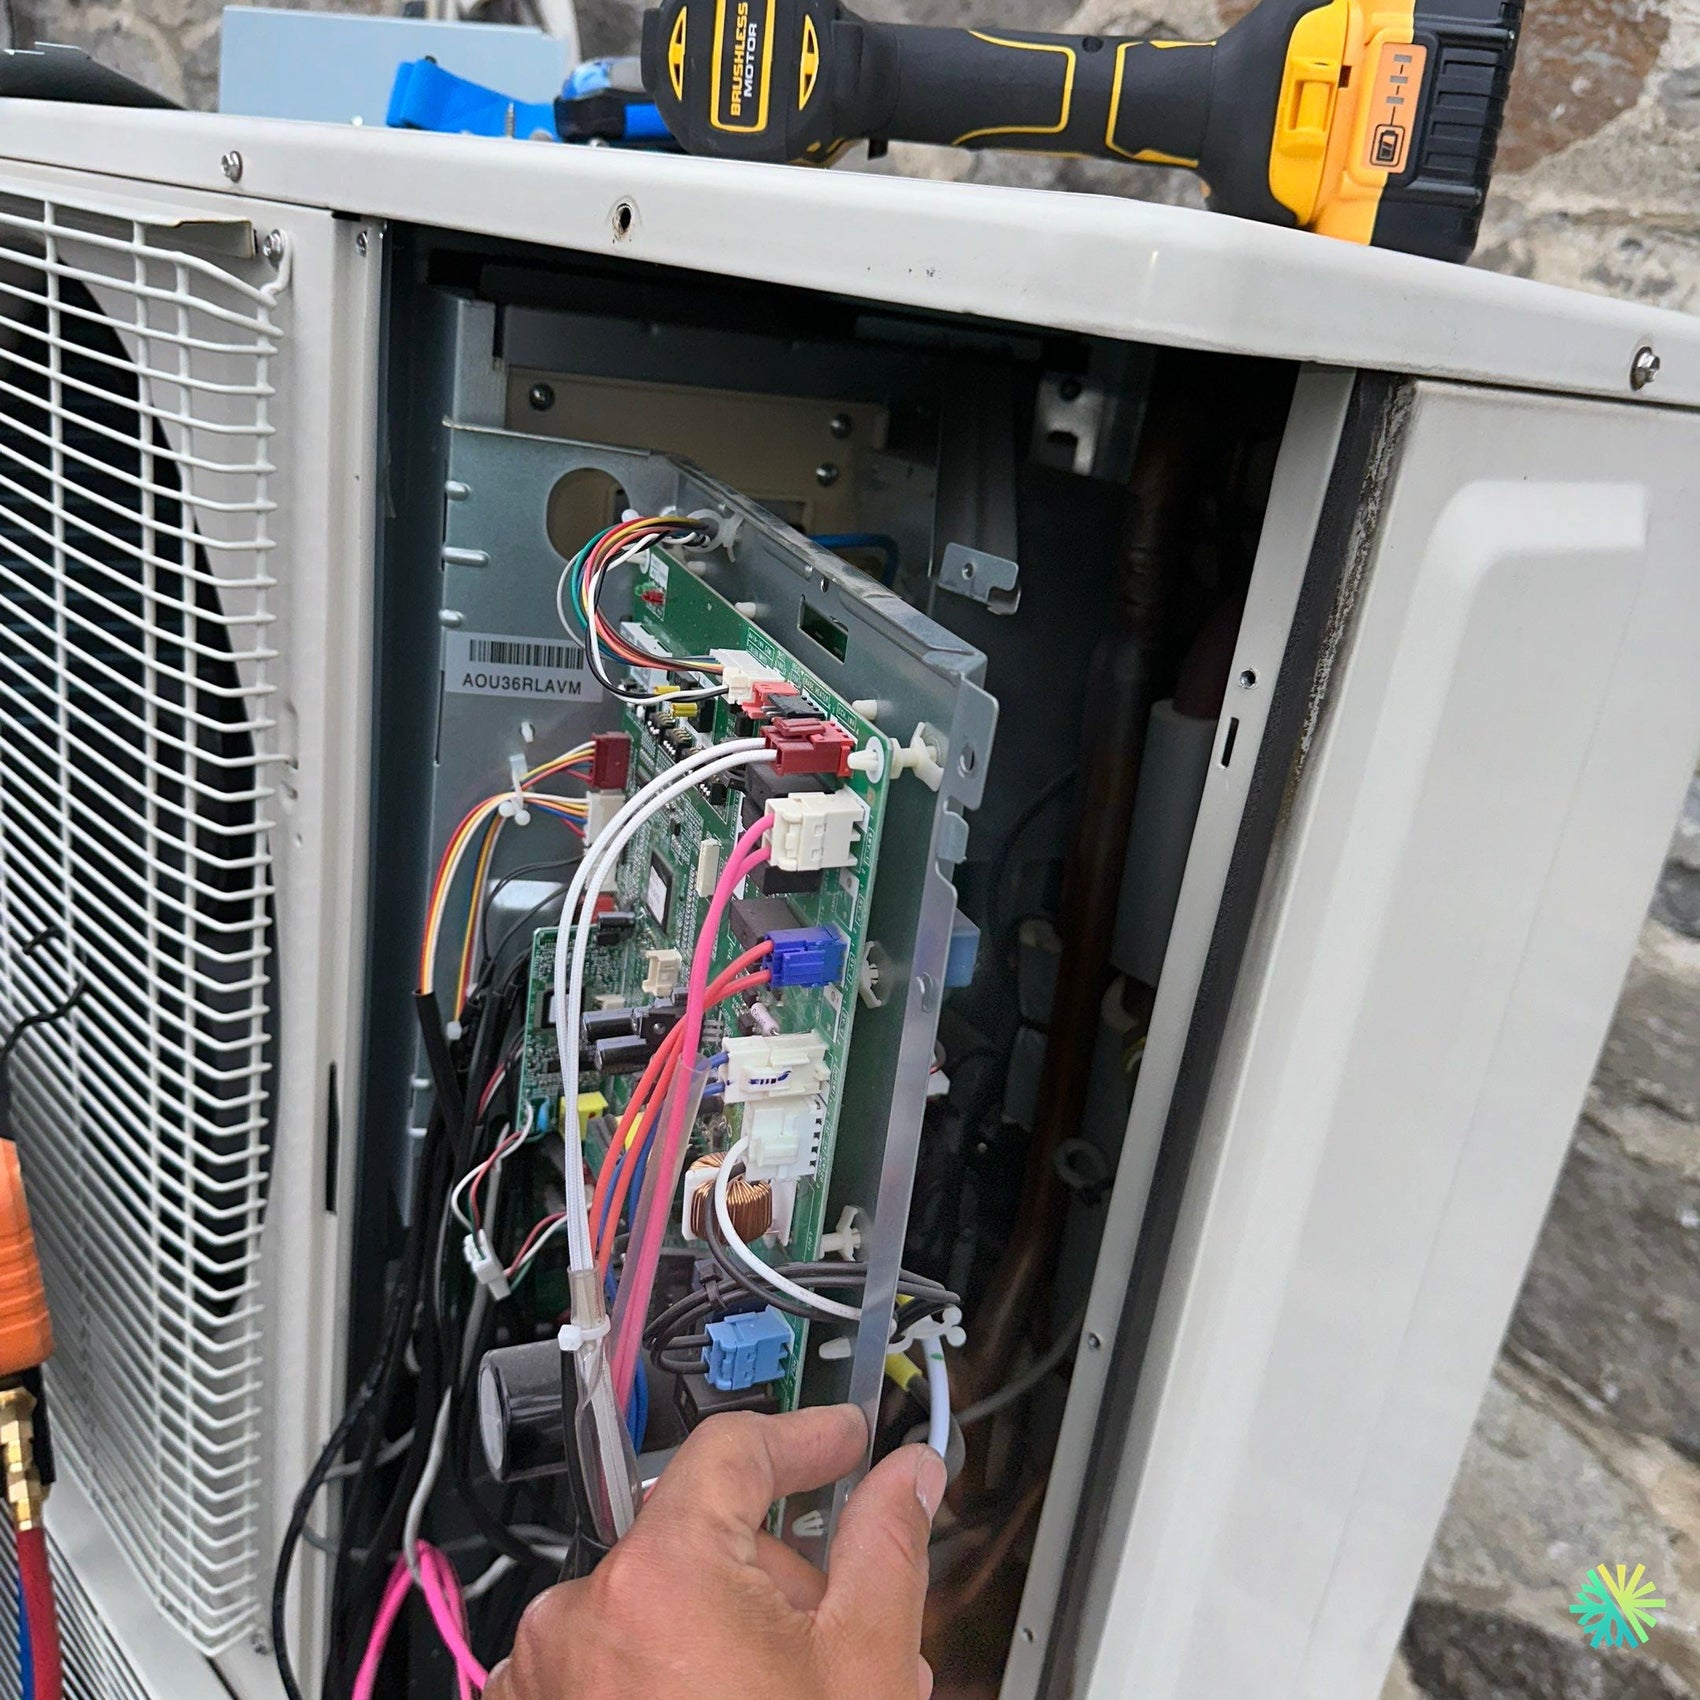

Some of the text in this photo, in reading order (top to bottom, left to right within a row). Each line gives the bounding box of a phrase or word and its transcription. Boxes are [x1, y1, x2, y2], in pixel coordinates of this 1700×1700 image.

[730, 2, 748, 116] BRUSHLESS
[744, 22, 757, 97] MOTOR
[462, 673, 582, 695] AOU36RLAVM
